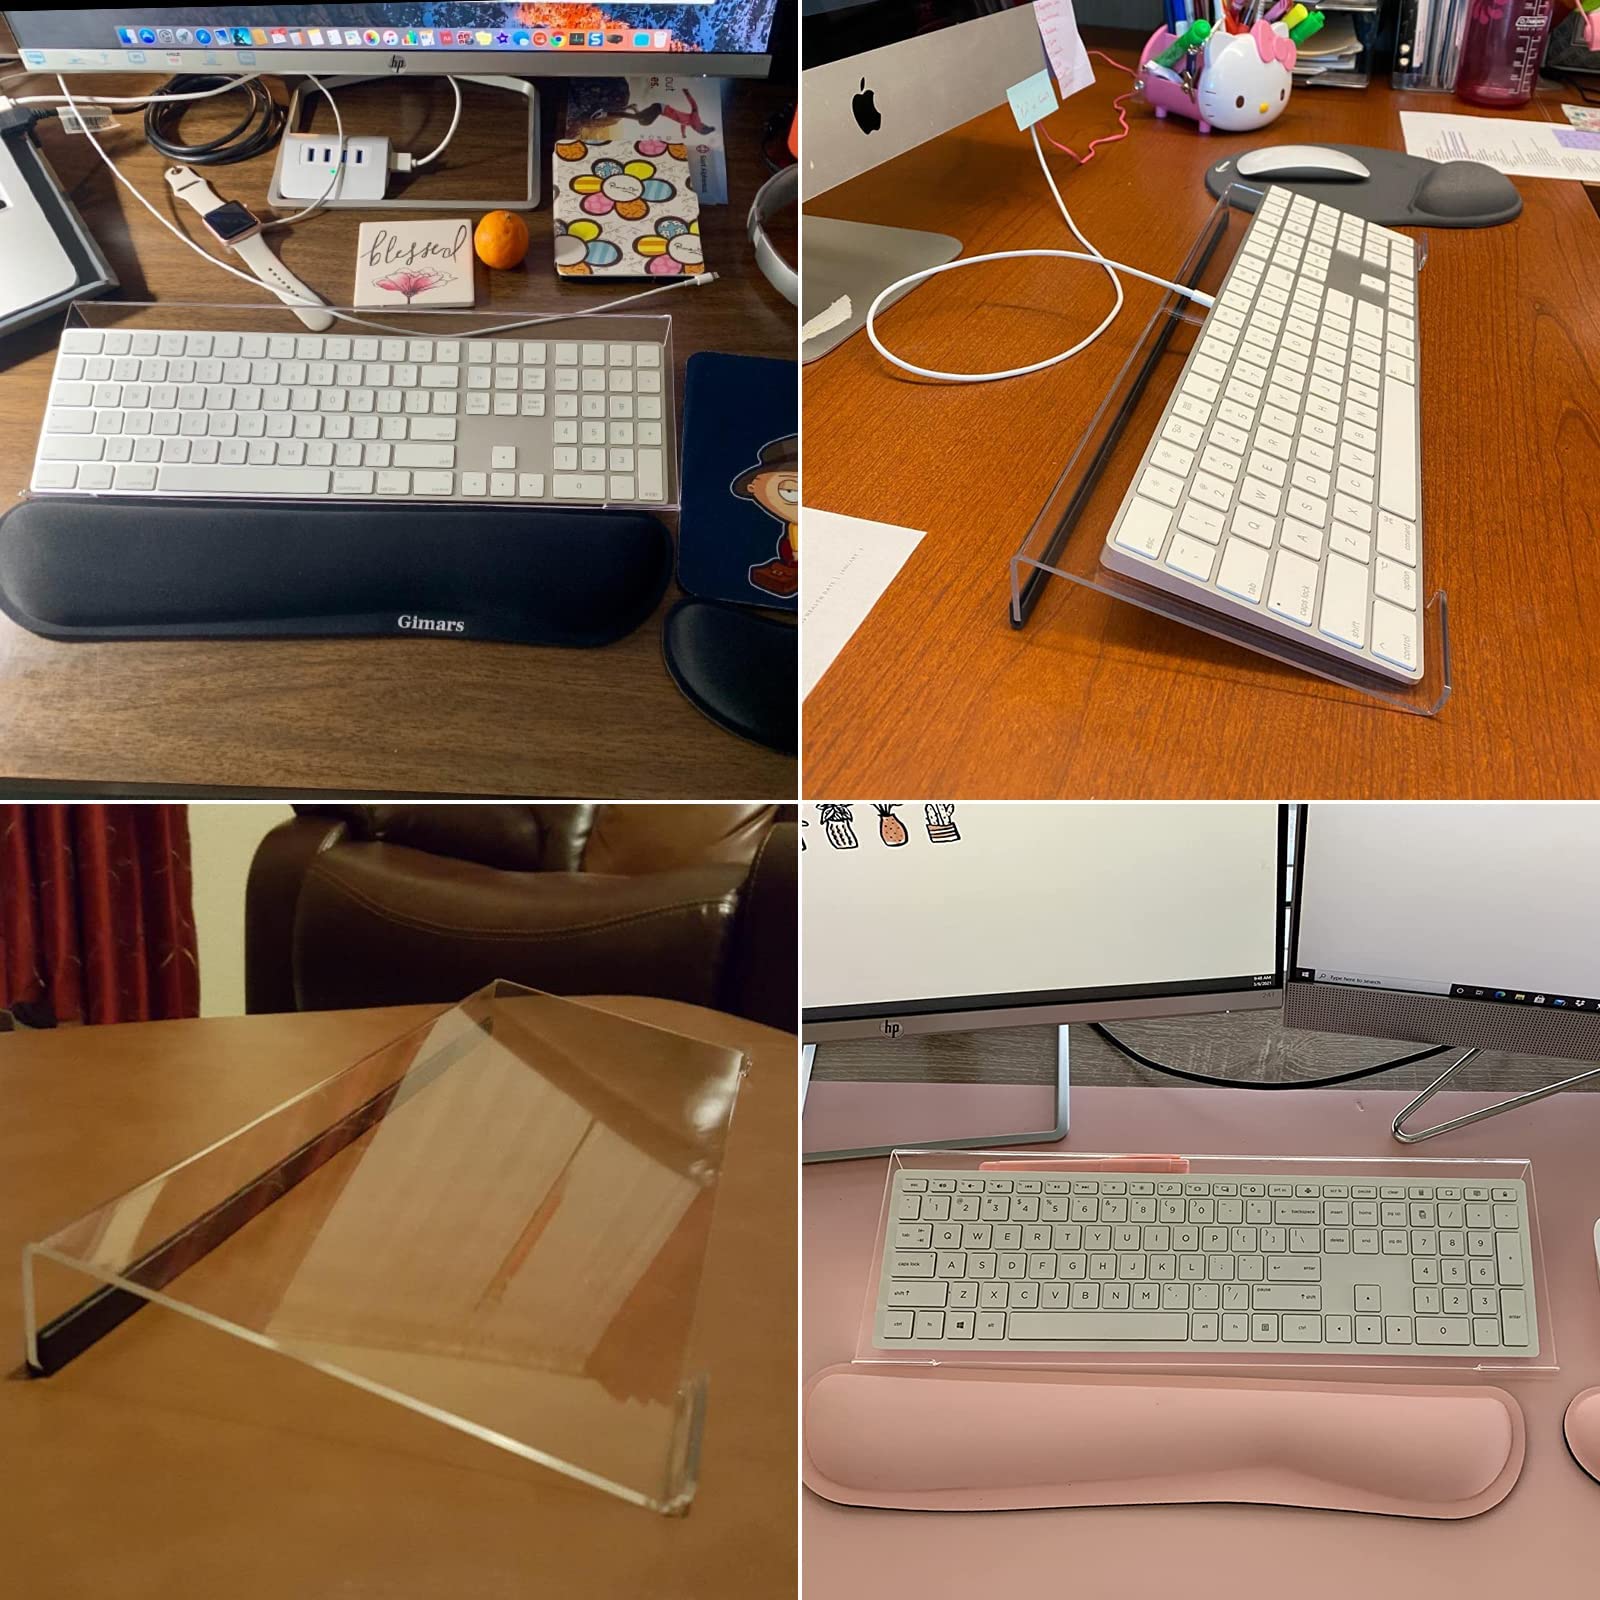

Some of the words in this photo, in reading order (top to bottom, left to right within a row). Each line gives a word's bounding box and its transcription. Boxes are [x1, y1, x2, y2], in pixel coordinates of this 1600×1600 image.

[389, 53, 404, 73] hp
[360, 224, 467, 266] blessed
[1146, 537, 1154, 549] esc
[1248, 582, 1257, 596] tab
[1301, 585, 1311, 600] lock
[1299, 600, 1308, 616] caps
[398, 614, 464, 632] Gimars
[884, 1020, 899, 1038] hp
[979, 1261, 985, 1269] S
[1021, 1291, 1028, 1299] C
